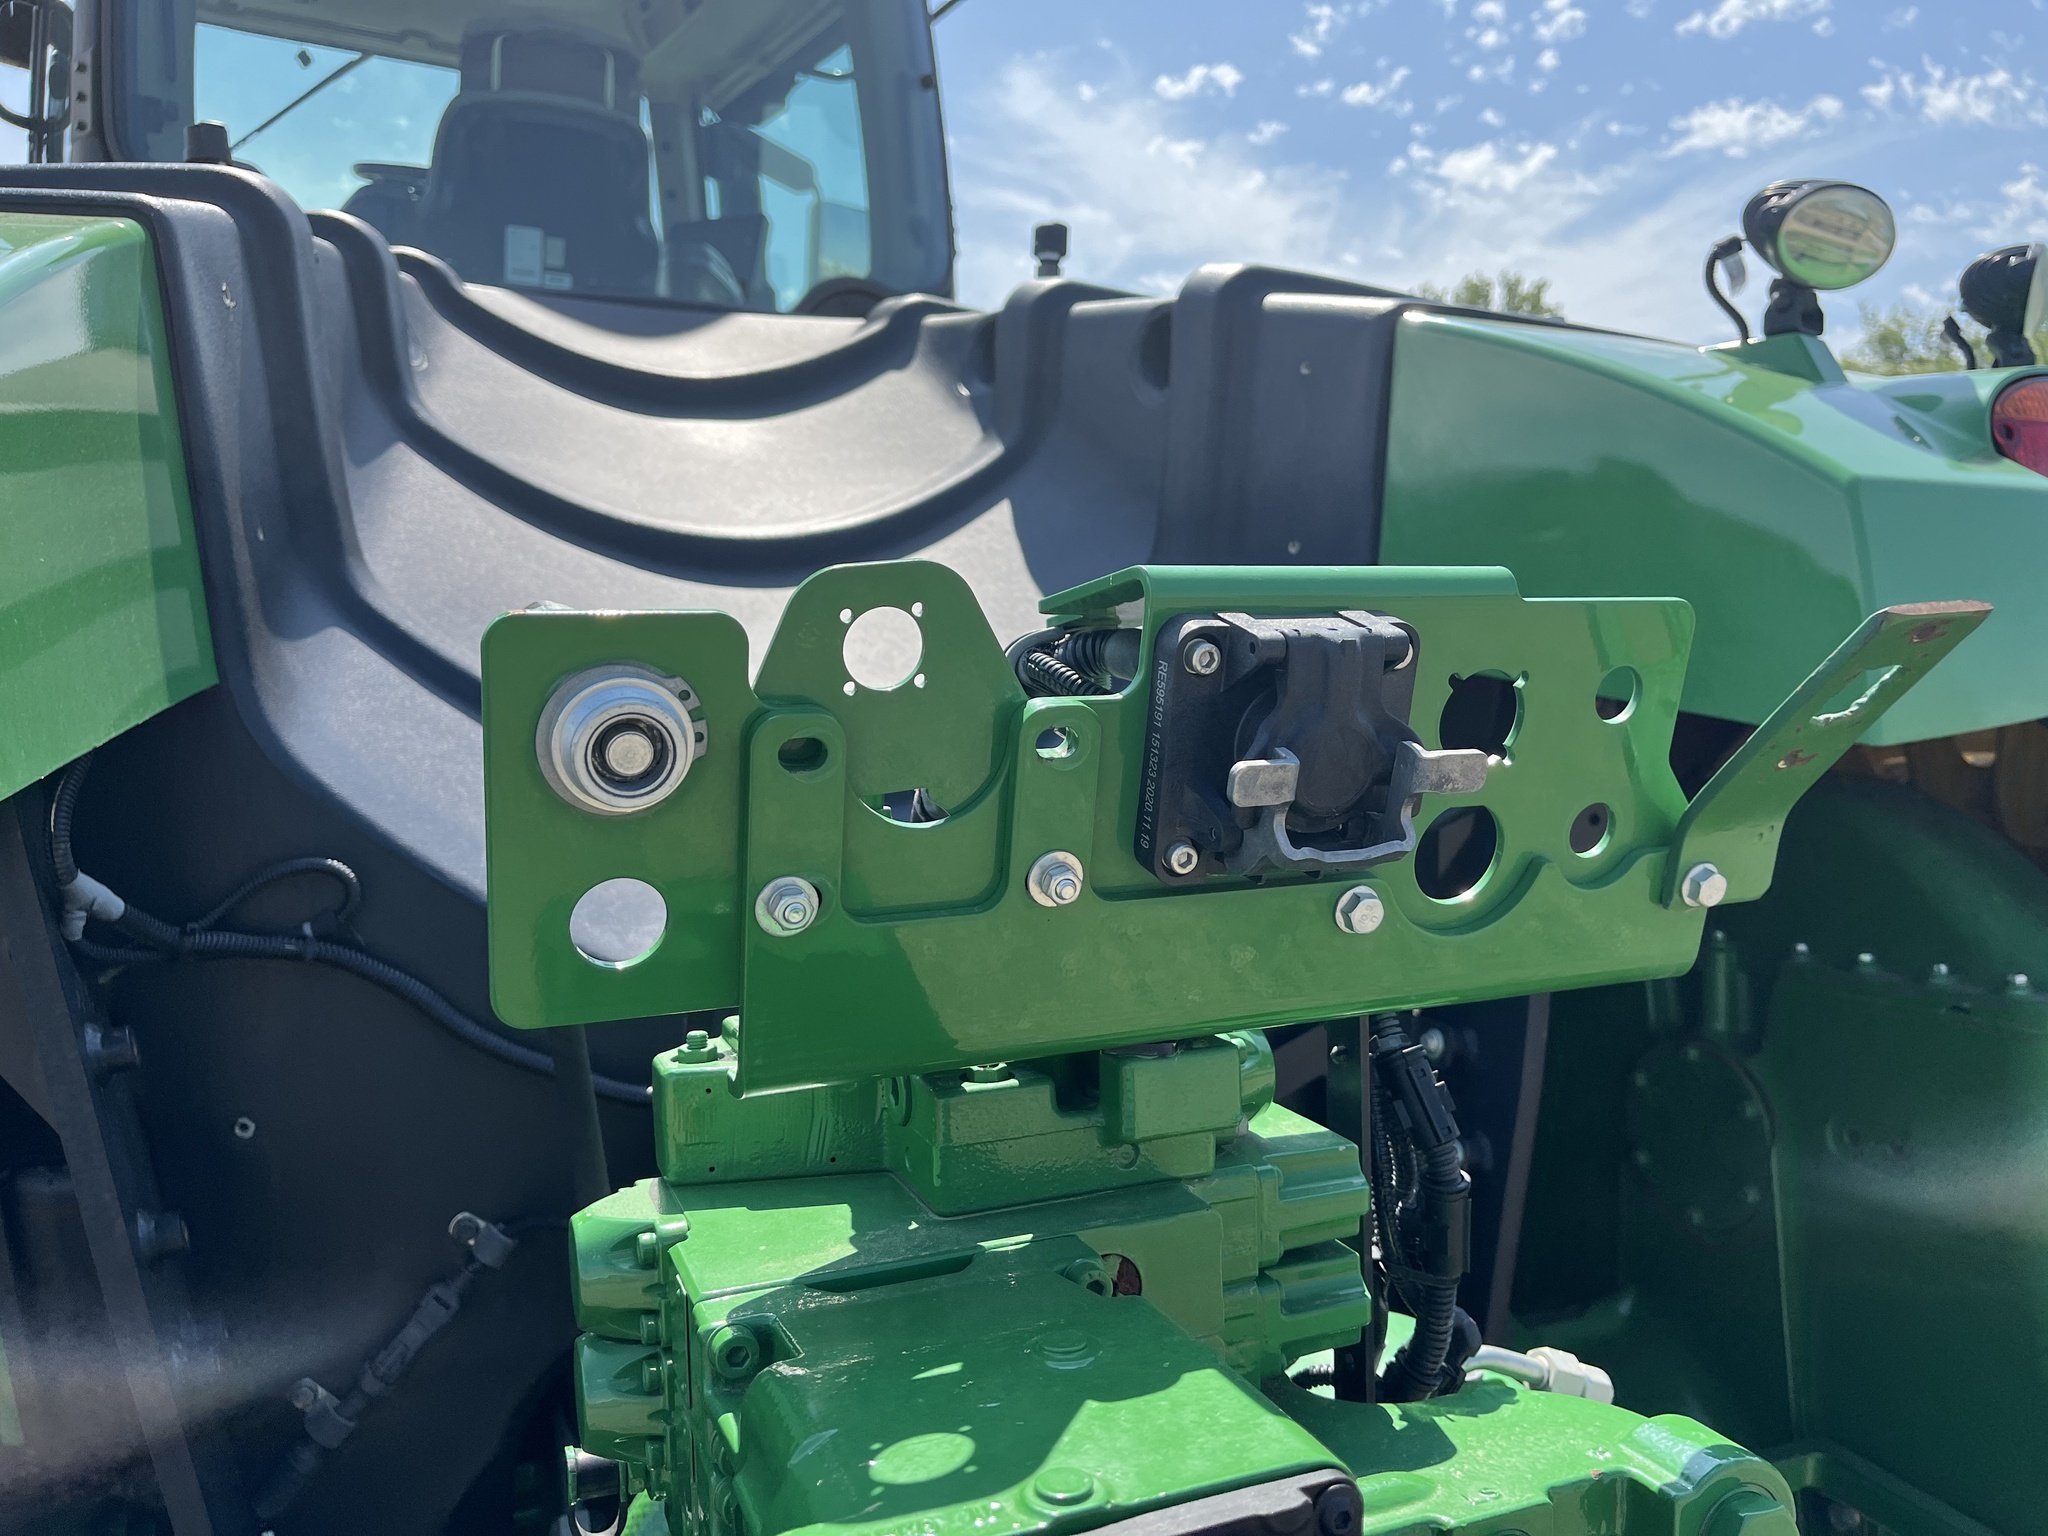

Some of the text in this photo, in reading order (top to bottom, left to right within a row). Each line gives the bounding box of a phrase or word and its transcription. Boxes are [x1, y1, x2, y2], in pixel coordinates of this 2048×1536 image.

[1140, 660, 1168, 849] RE595191 151323 2020.11.19
